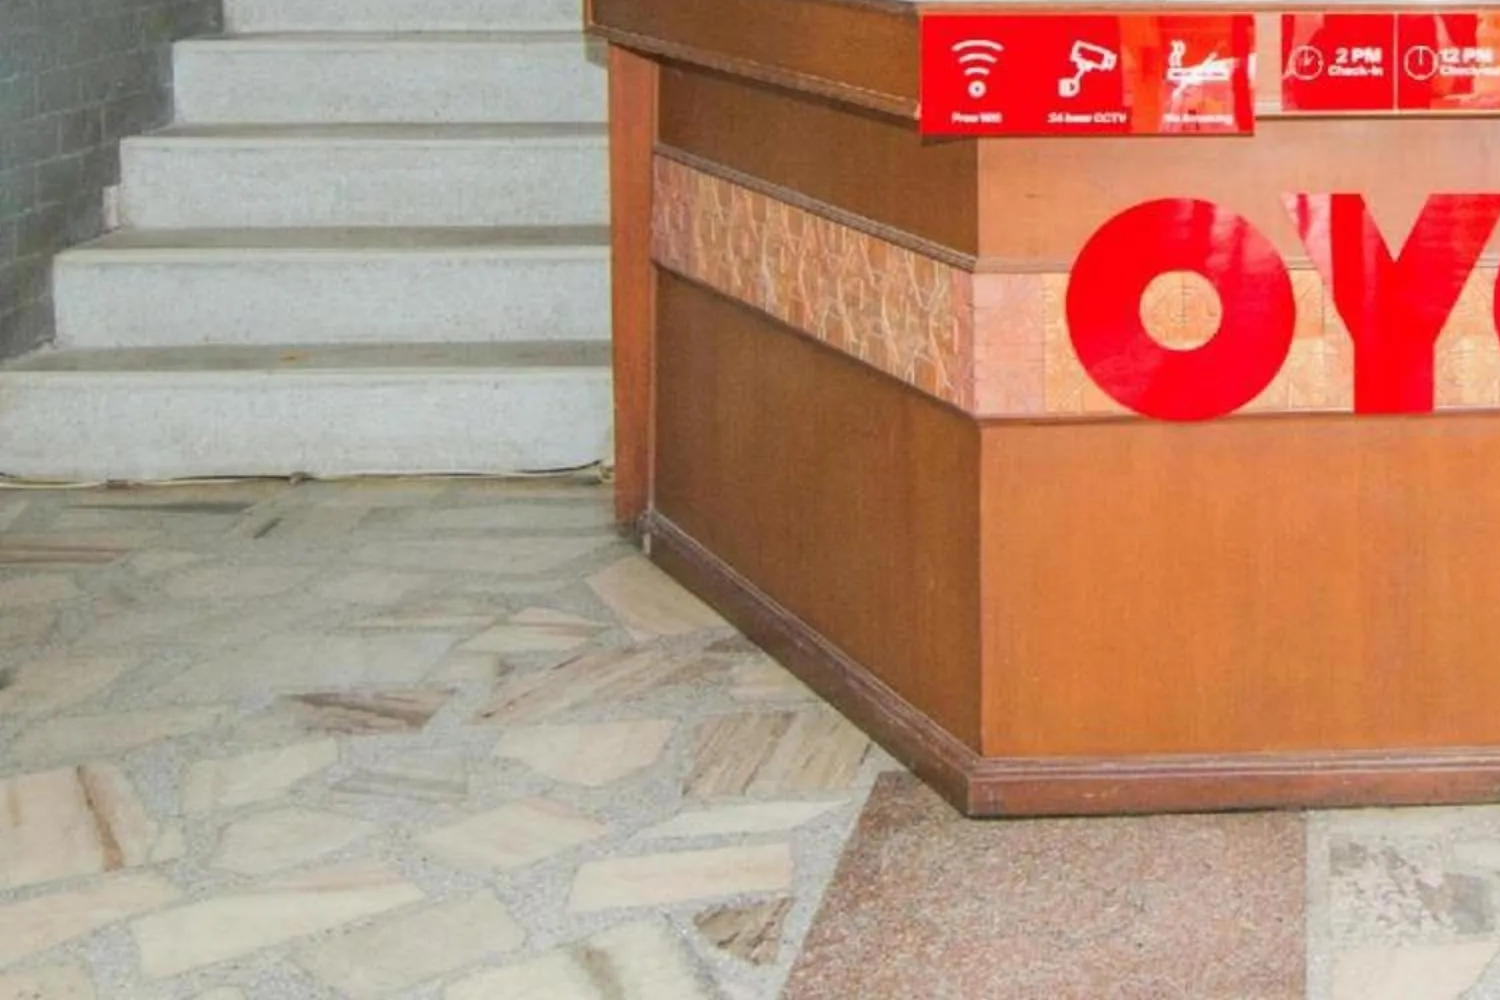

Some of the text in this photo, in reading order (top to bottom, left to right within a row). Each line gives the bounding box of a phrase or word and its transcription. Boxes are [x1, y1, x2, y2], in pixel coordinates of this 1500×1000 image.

[1335, 47, 1383, 64] 2 PM
[1440, 47, 1494, 64] 12 PM
[1093, 111, 1127, 123] CCTV
